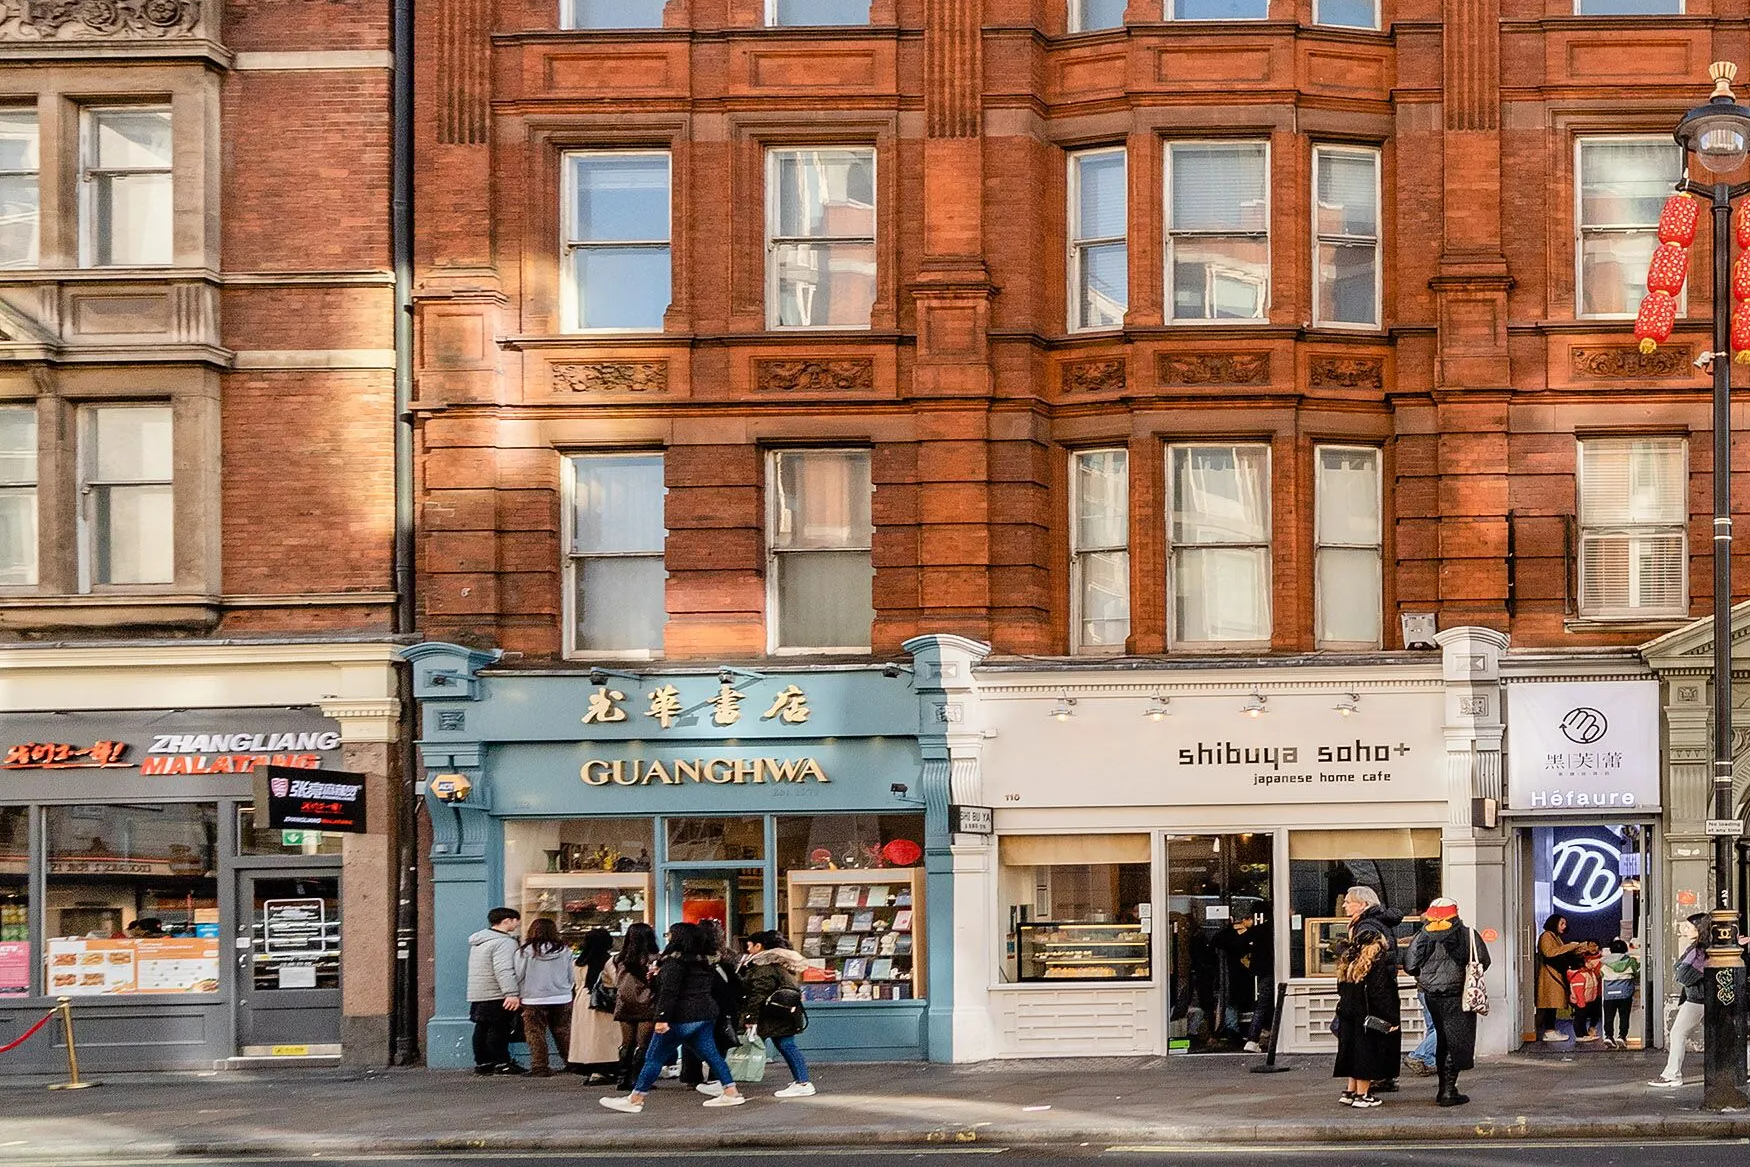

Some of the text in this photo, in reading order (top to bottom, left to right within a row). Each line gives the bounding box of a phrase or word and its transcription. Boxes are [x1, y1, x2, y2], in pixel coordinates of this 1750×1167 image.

[581, 684, 812, 729] 光華書店
[148, 732, 342, 753] ZHANGLIANG
[1179, 742, 1298, 770] shibuya
[580, 757, 829, 785] GUANGHWA
[1254, 771, 1391, 786] japanese home cafe
[1005, 794, 1021, 802] 110
[1531, 789, 1635, 807] Héfaure
